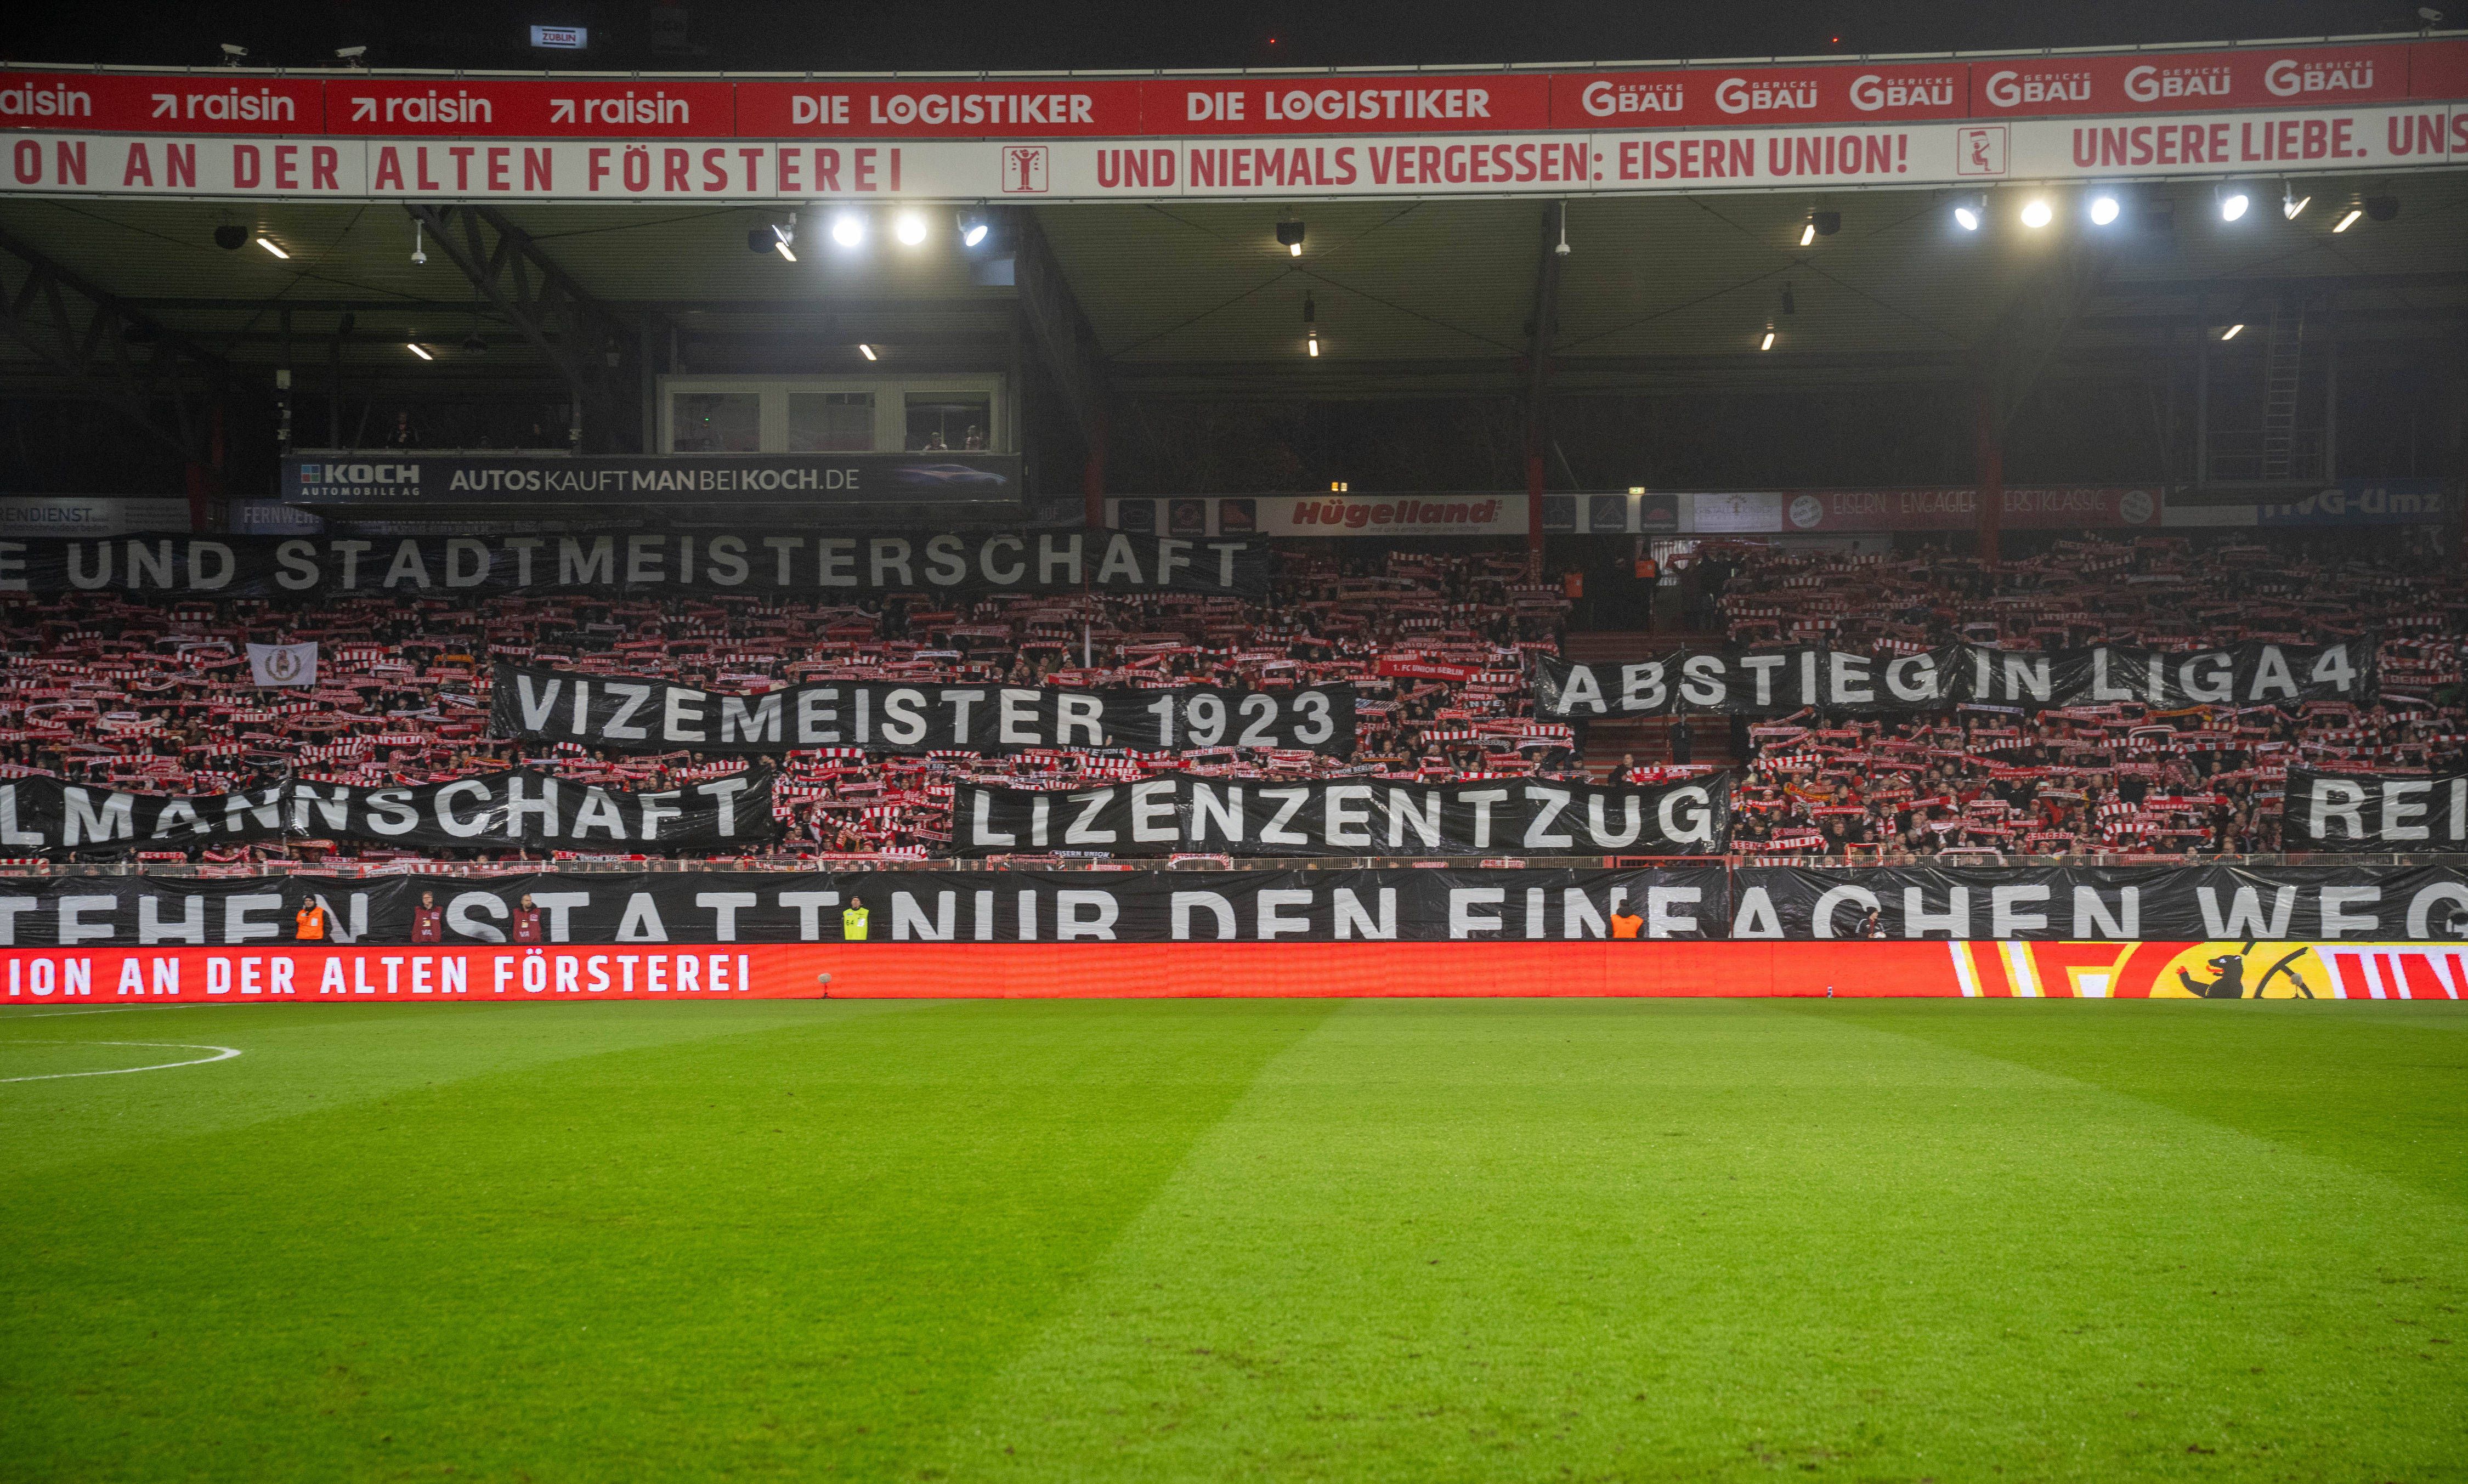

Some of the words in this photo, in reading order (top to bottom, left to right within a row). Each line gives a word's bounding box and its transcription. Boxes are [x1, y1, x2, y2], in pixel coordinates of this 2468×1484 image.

[1887, 77, 1953, 86] GERICKE
[2024, 72, 2090, 82] GERICKE
[2163, 67, 2231, 76] GERICKE
[2305, 61, 2373, 70] GERICKE
[1618, 83, 1683, 92] GERICKE
[1752, 81, 1818, 89] GERICKE
[187, 88, 295, 121] raisin
[387, 90, 491, 123] raisin
[585, 92, 689, 123] raisin
[793, 95, 848, 124] DIE
[871, 94, 1094, 124] LOGISTIKER
[1187, 92, 1244, 121] DIE
[1265, 89, 1491, 121] LOGISTIKER
[2073, 124, 2229, 167] UNSERE
[2241, 118, 2367, 162] LIEBE.
[14, 140, 86, 185] ON
[123, 143, 196, 188] AN
[234, 145, 339, 190] DER
[376, 147, 552, 191] ALTEN
[589, 144, 901, 192] FÖRSTEREI
[1097, 149, 1175, 188] UND
[1191, 146, 1356, 187] NIEMALS
[1369, 143, 1603, 184] VERGESSEN:
[1620, 138, 1754, 180] EISERN
[1769, 134, 1907, 176] UNION!
[325, 465, 420, 484] KOCH
[302, 487, 395, 496] AUTOMOBILE
[403, 487, 420, 496] AG
[1833, 493, 1886, 514] EISERN
[1292, 500, 1496, 528] Hügelland
[66, 540, 235, 590] UND
[275, 533, 1248, 591] STADTMEISTERSCHAFT
[1436, 666, 1464, 676] BERLIN
[1558, 652, 1938, 713] ABSTIEG
[1974, 648, 2050, 700] IN
[517, 675, 1103, 745] VIZEMEISTER
[1147, 691, 1334, 746] 1923
[0, 777, 748, 847] LMANNSCHAFT
[973, 779, 1711, 849] LIZENZENTZUG
[2309, 778, 2467, 841] REI
[446, 891, 840, 943] STATT
[892, 890, 1119, 941] NUR
[1171, 887, 1397, 940] DEN
[1450, 885, 2139, 939] EINFACHEN
[9, 958, 91, 996] ION
[117, 958, 179, 996] AN
[207, 957, 296, 995] DER
[320, 956, 467, 994] ALTEN
[495, 948, 749, 994] FÖRSTEREI
